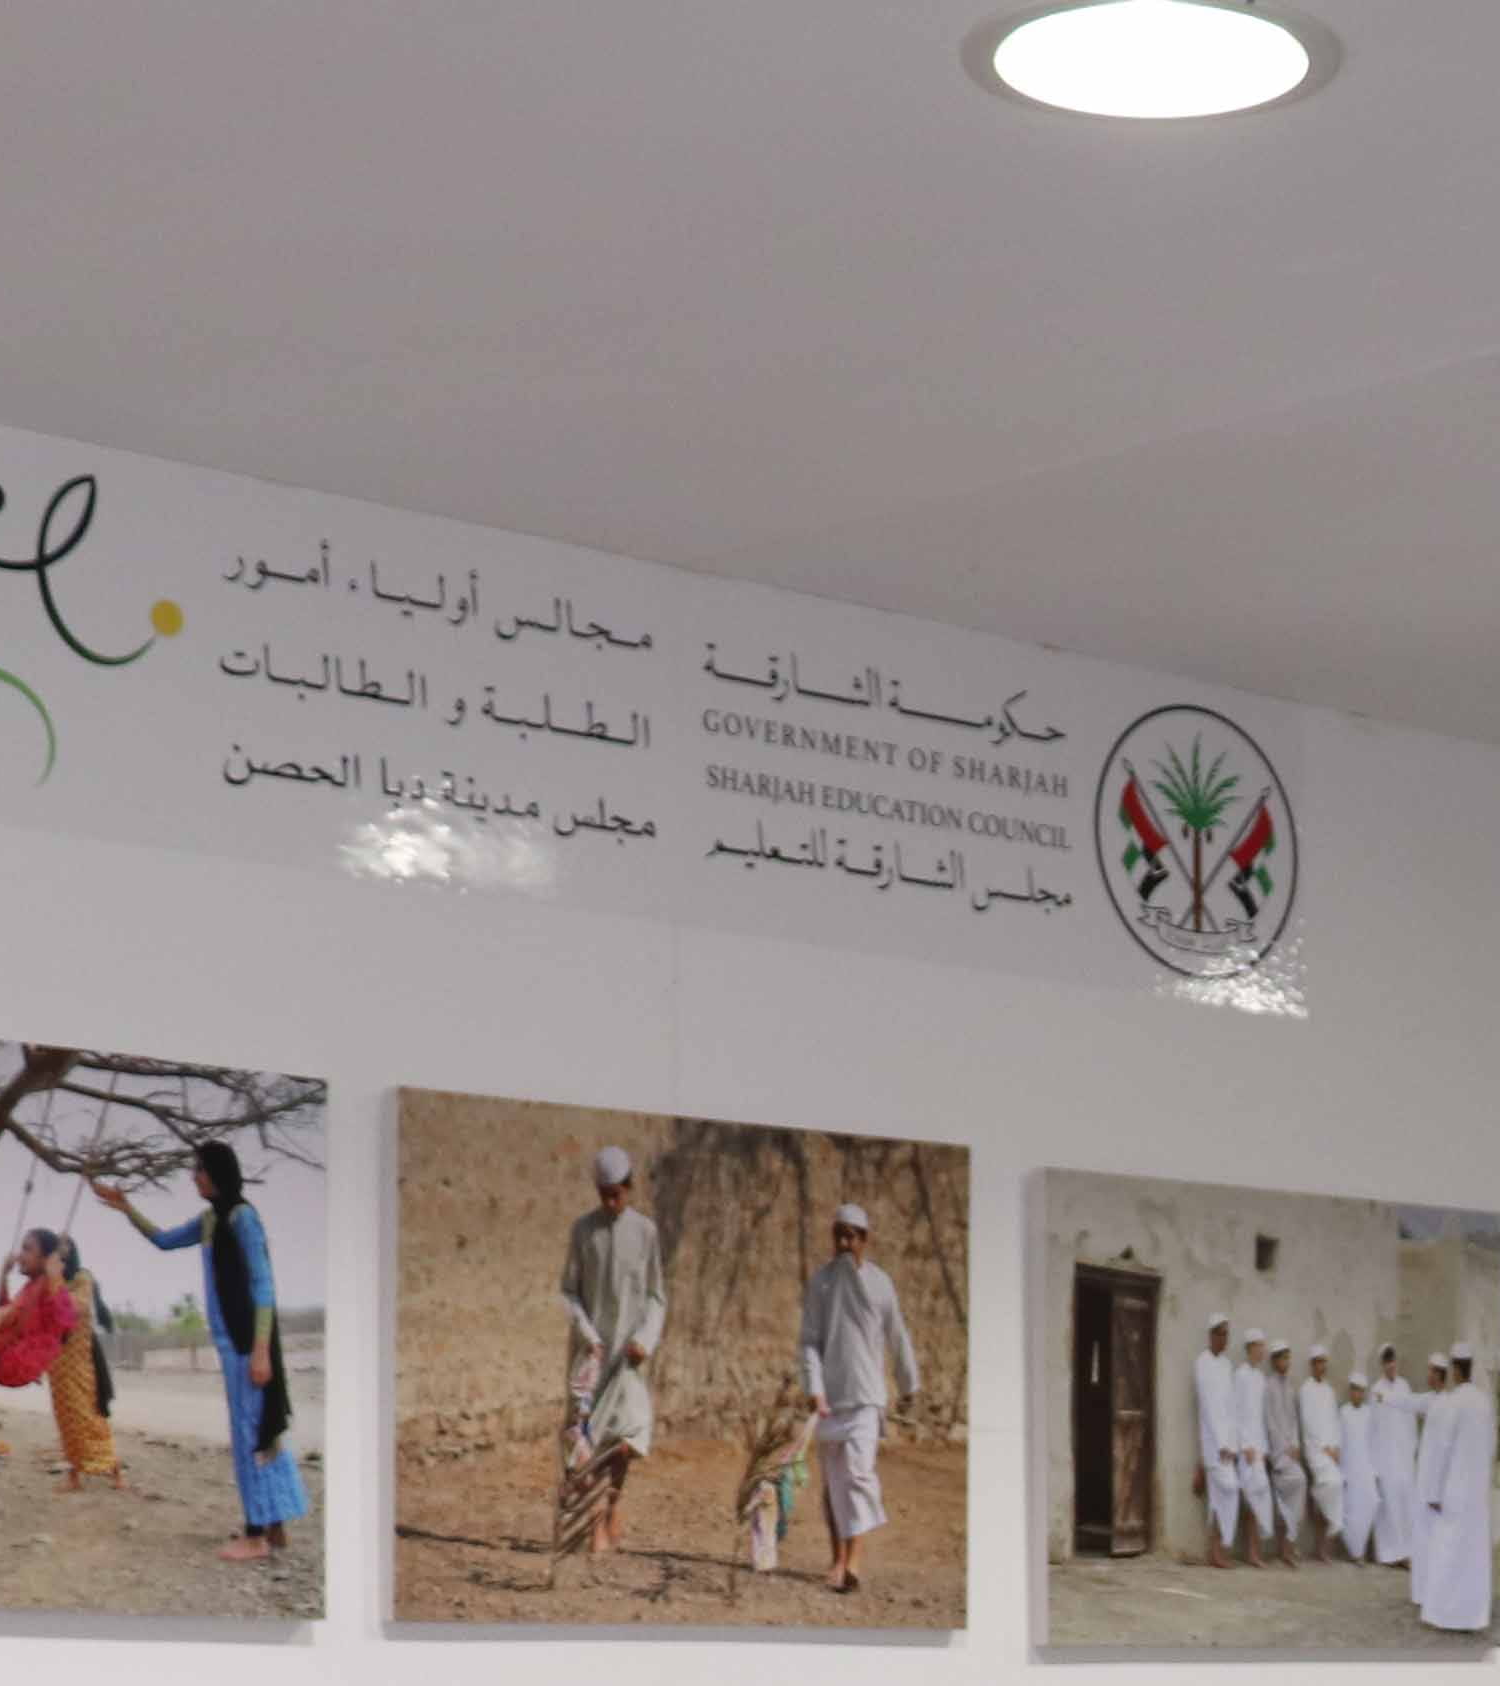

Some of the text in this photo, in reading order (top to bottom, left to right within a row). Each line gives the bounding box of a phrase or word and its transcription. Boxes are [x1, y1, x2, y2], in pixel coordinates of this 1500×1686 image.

[222, 538, 654, 654] مجالس أولياء أمور
[218, 642, 651, 749] الطلبة و الطالبات
[701, 642, 1068, 747] حكومة الشارقة
[222, 742, 658, 845] مجلس مدينة دبا الحصن
[701, 707, 1070, 800] GOVERNMENT OF SHARJAH
[704, 763, 1072, 851] SHARJAH EDUCATION COUNCIL
[704, 817, 1073, 916] مجلس الشارقة للتعليم
